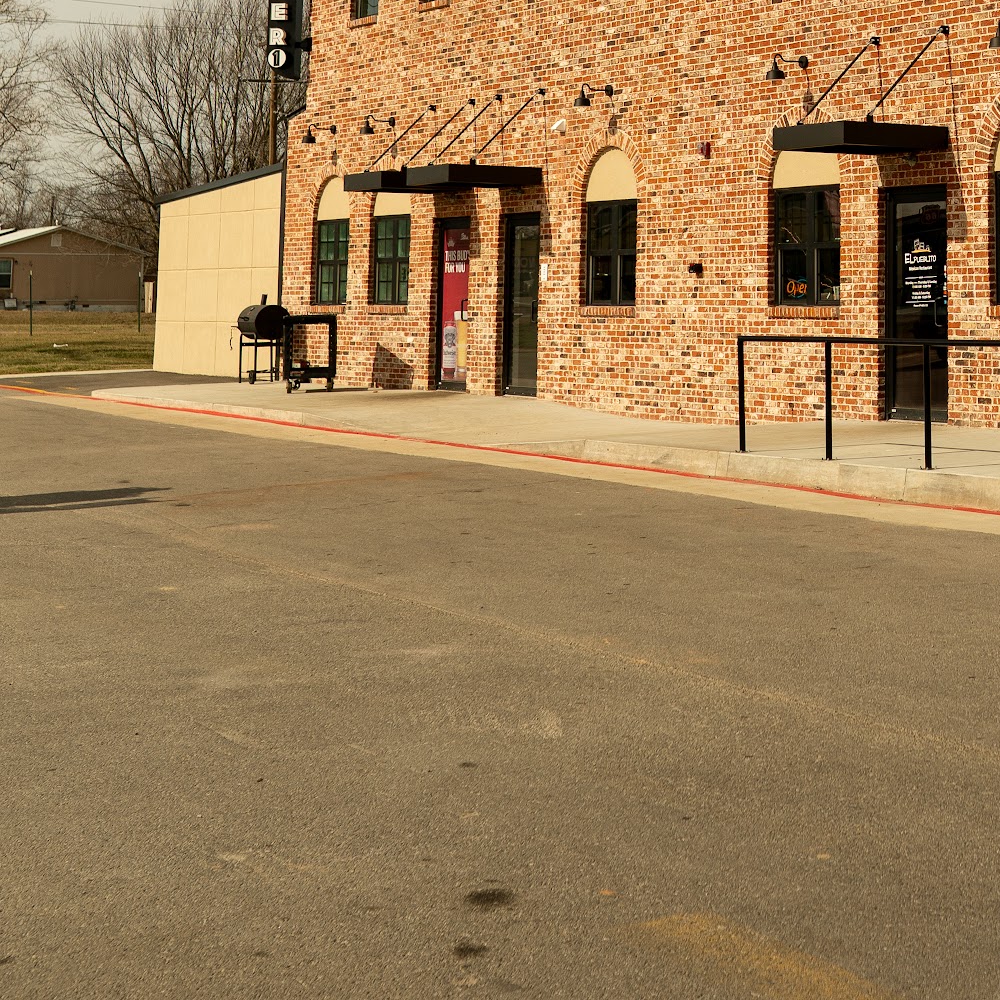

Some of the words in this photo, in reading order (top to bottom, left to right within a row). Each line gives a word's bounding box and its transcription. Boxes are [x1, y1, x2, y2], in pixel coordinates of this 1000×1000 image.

[271, 49, 281, 67] 1
[445, 250, 456, 261] THIS
[905, 253, 915, 264] EL
[913, 255, 936, 263] PUEBLITO
[445, 262, 455, 273] FOR
[455, 262, 466, 273] YOU
